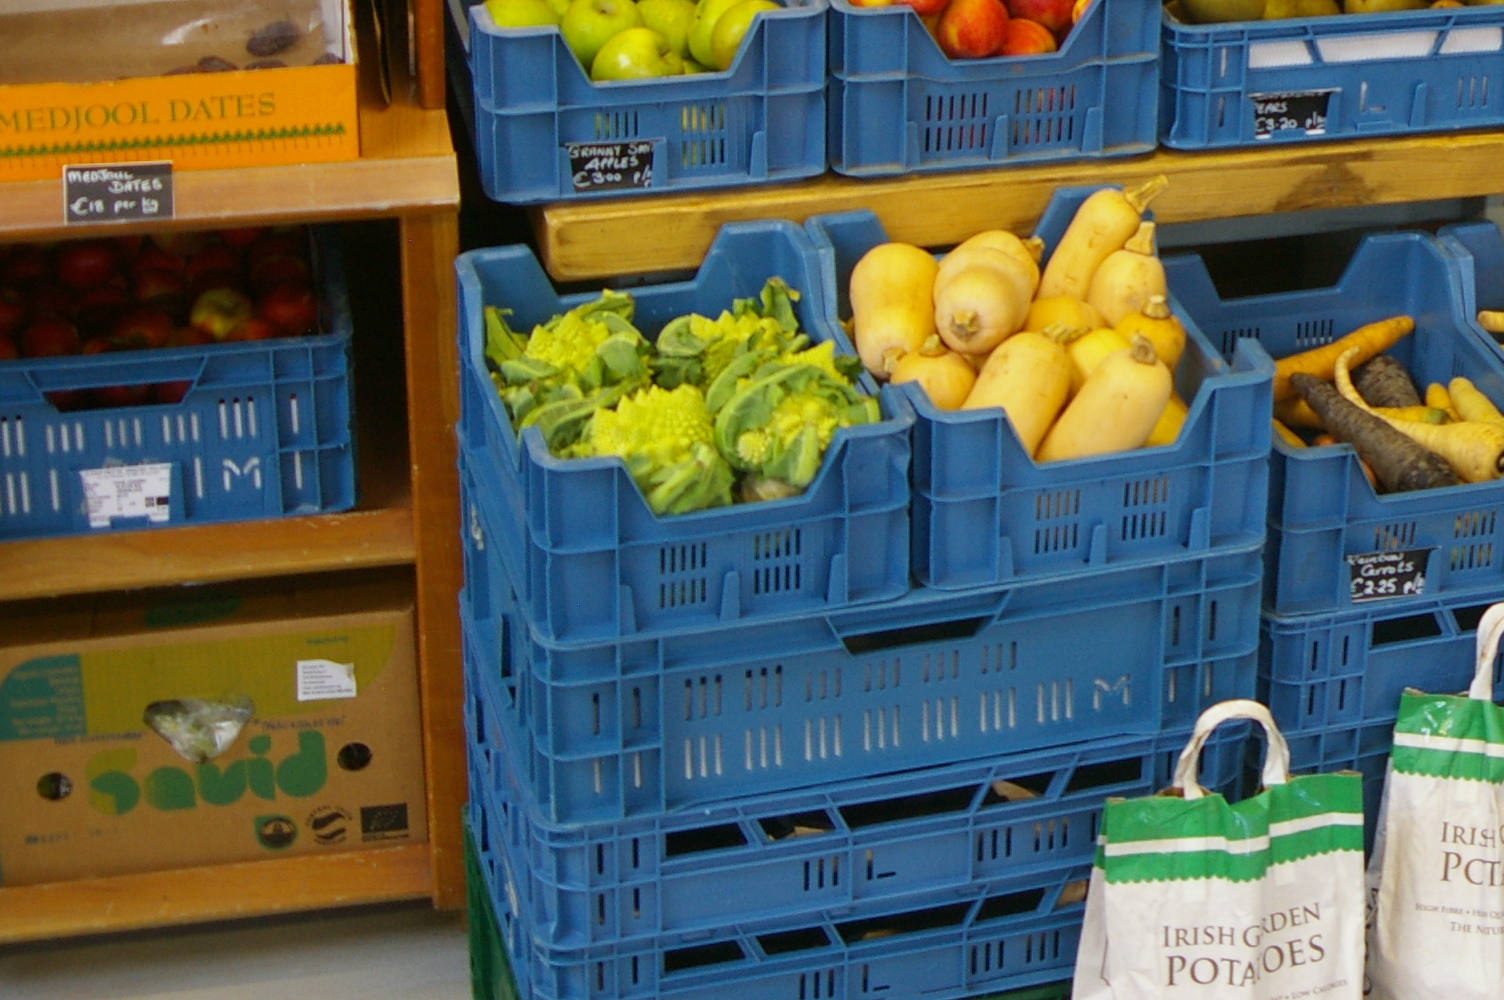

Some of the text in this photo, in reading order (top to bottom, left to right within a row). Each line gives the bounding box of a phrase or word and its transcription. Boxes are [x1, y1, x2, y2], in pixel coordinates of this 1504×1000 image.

[169, 92, 276, 123] DATES
[568, 145, 621, 159] GRANNY
[108, 177, 163, 194] DATES
[1163, 902, 1321, 948] IRISH GDEN
